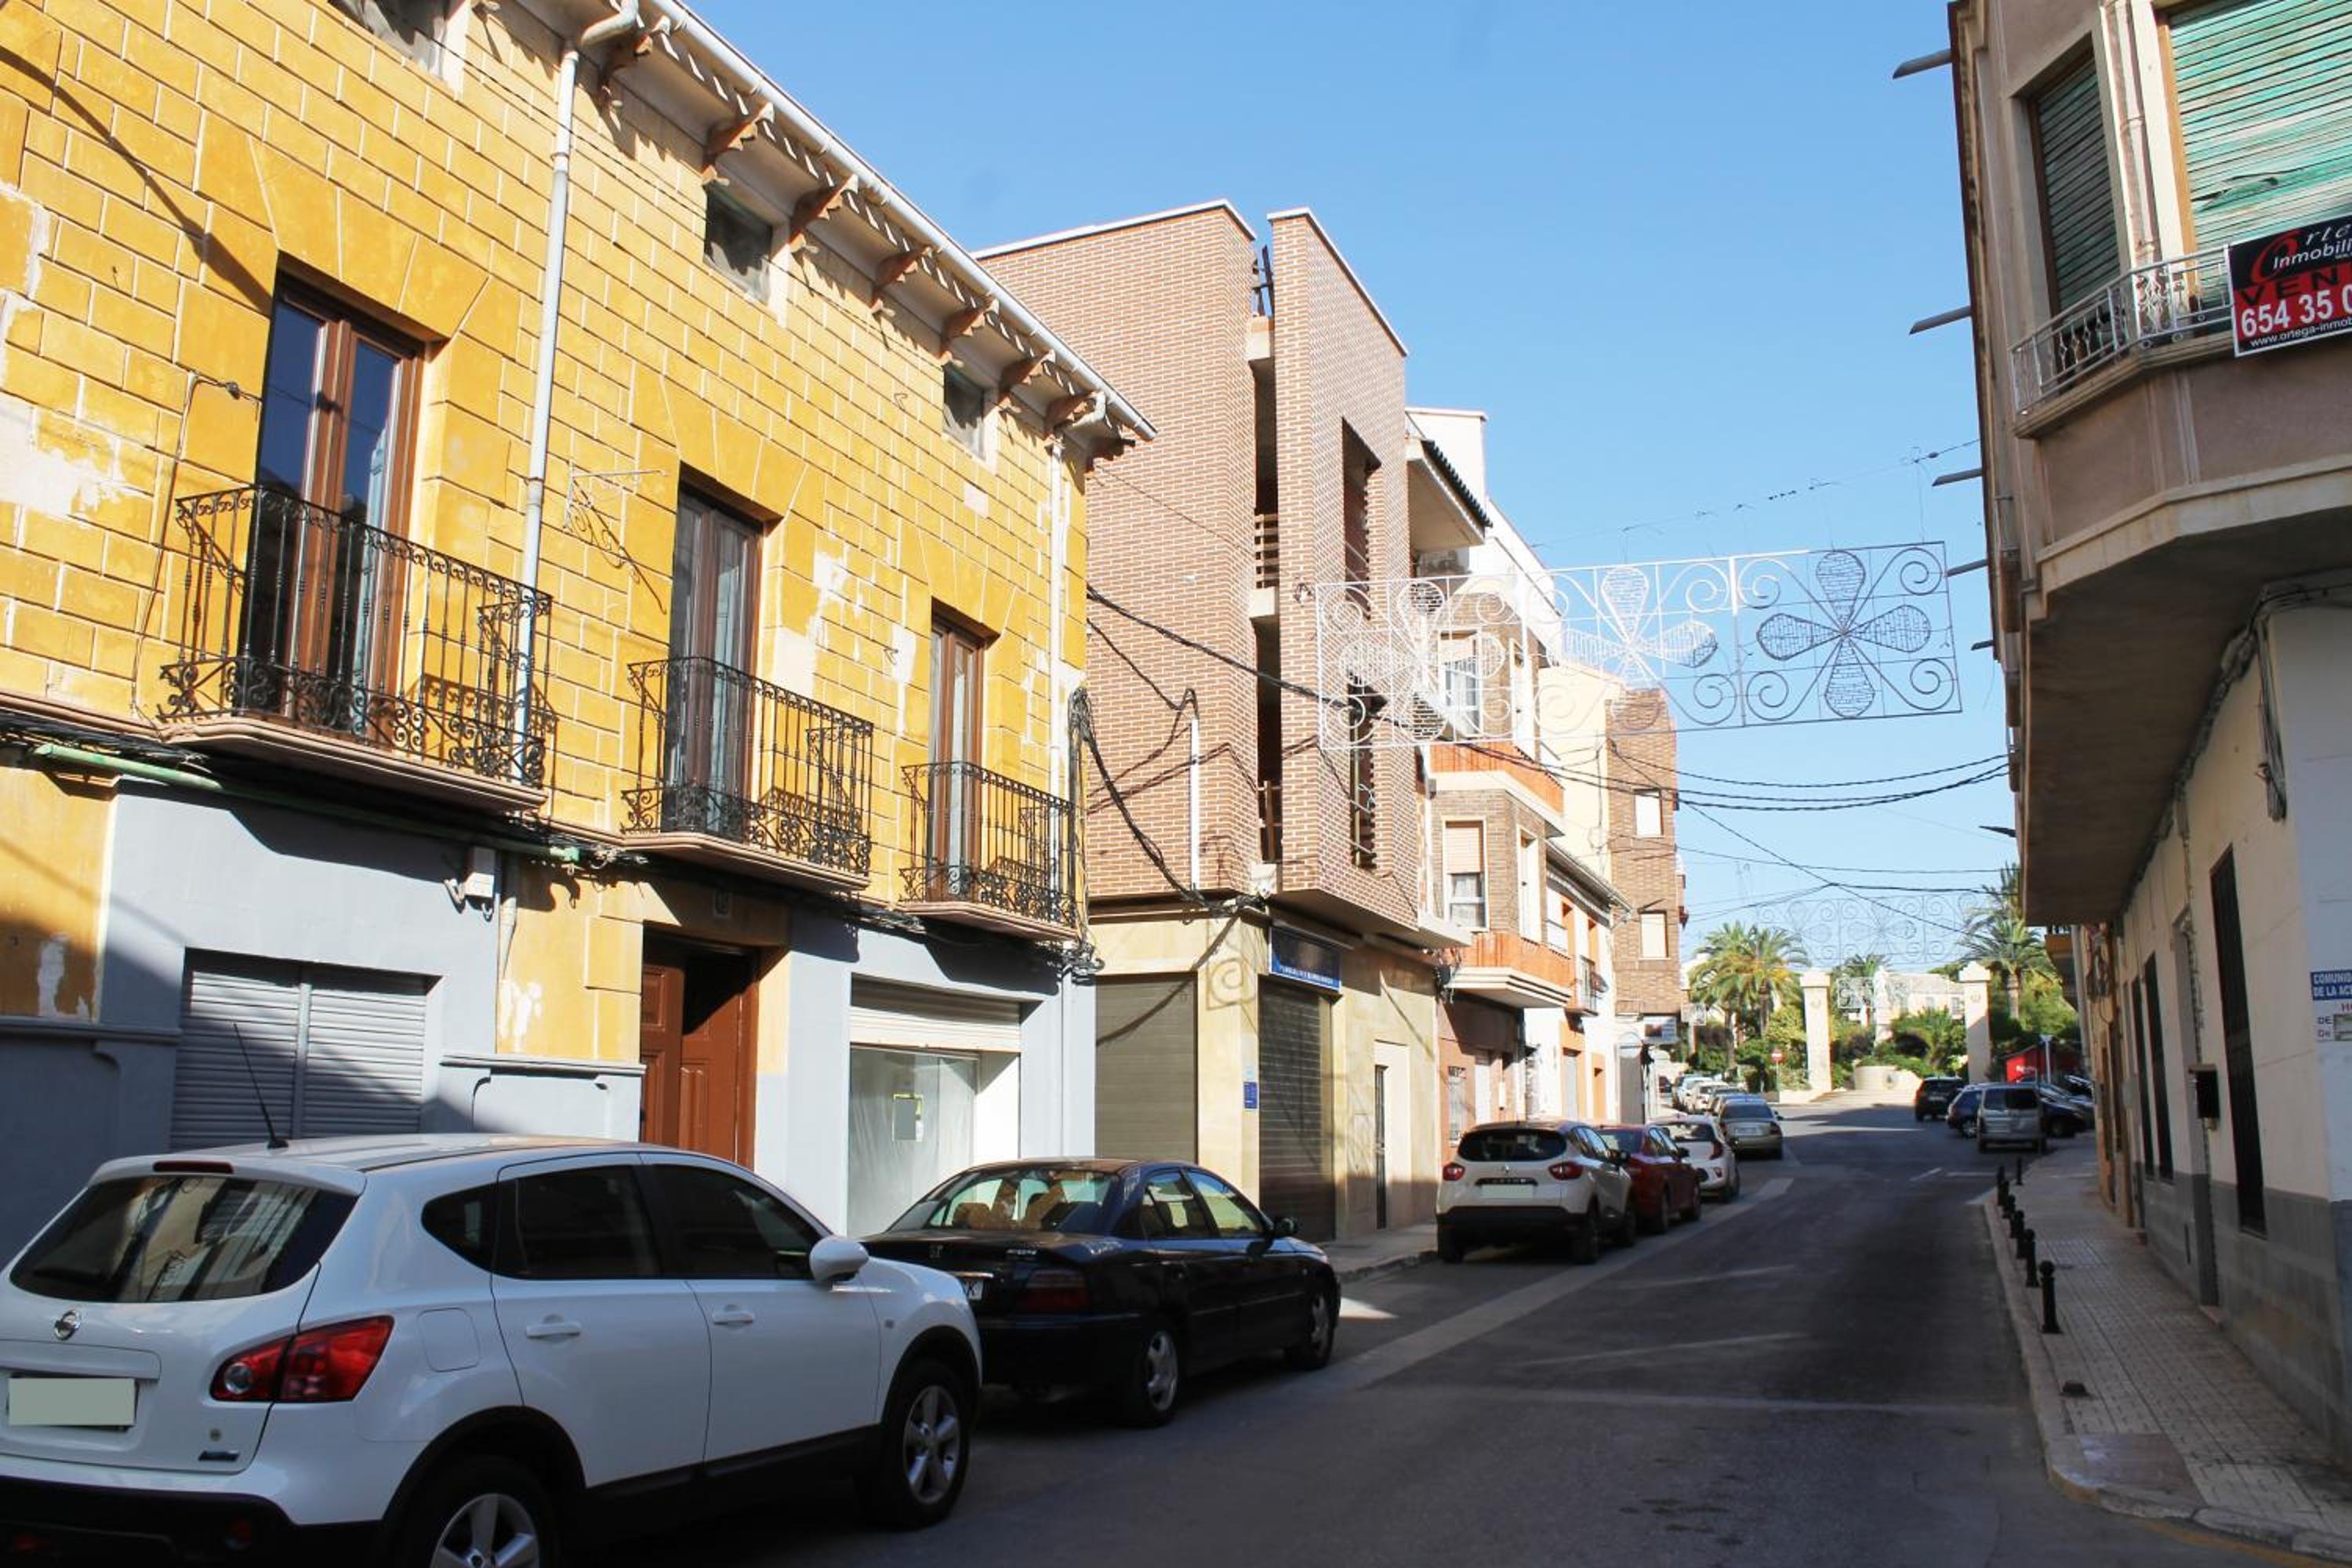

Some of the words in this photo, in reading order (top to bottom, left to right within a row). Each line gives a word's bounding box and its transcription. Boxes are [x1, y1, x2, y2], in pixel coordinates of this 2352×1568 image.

[2241, 299, 2290, 337] 654
[2299, 289, 2333, 324] 35
[2314, 987, 2324, 996] DE
[2326, 985, 2337, 996] LA
